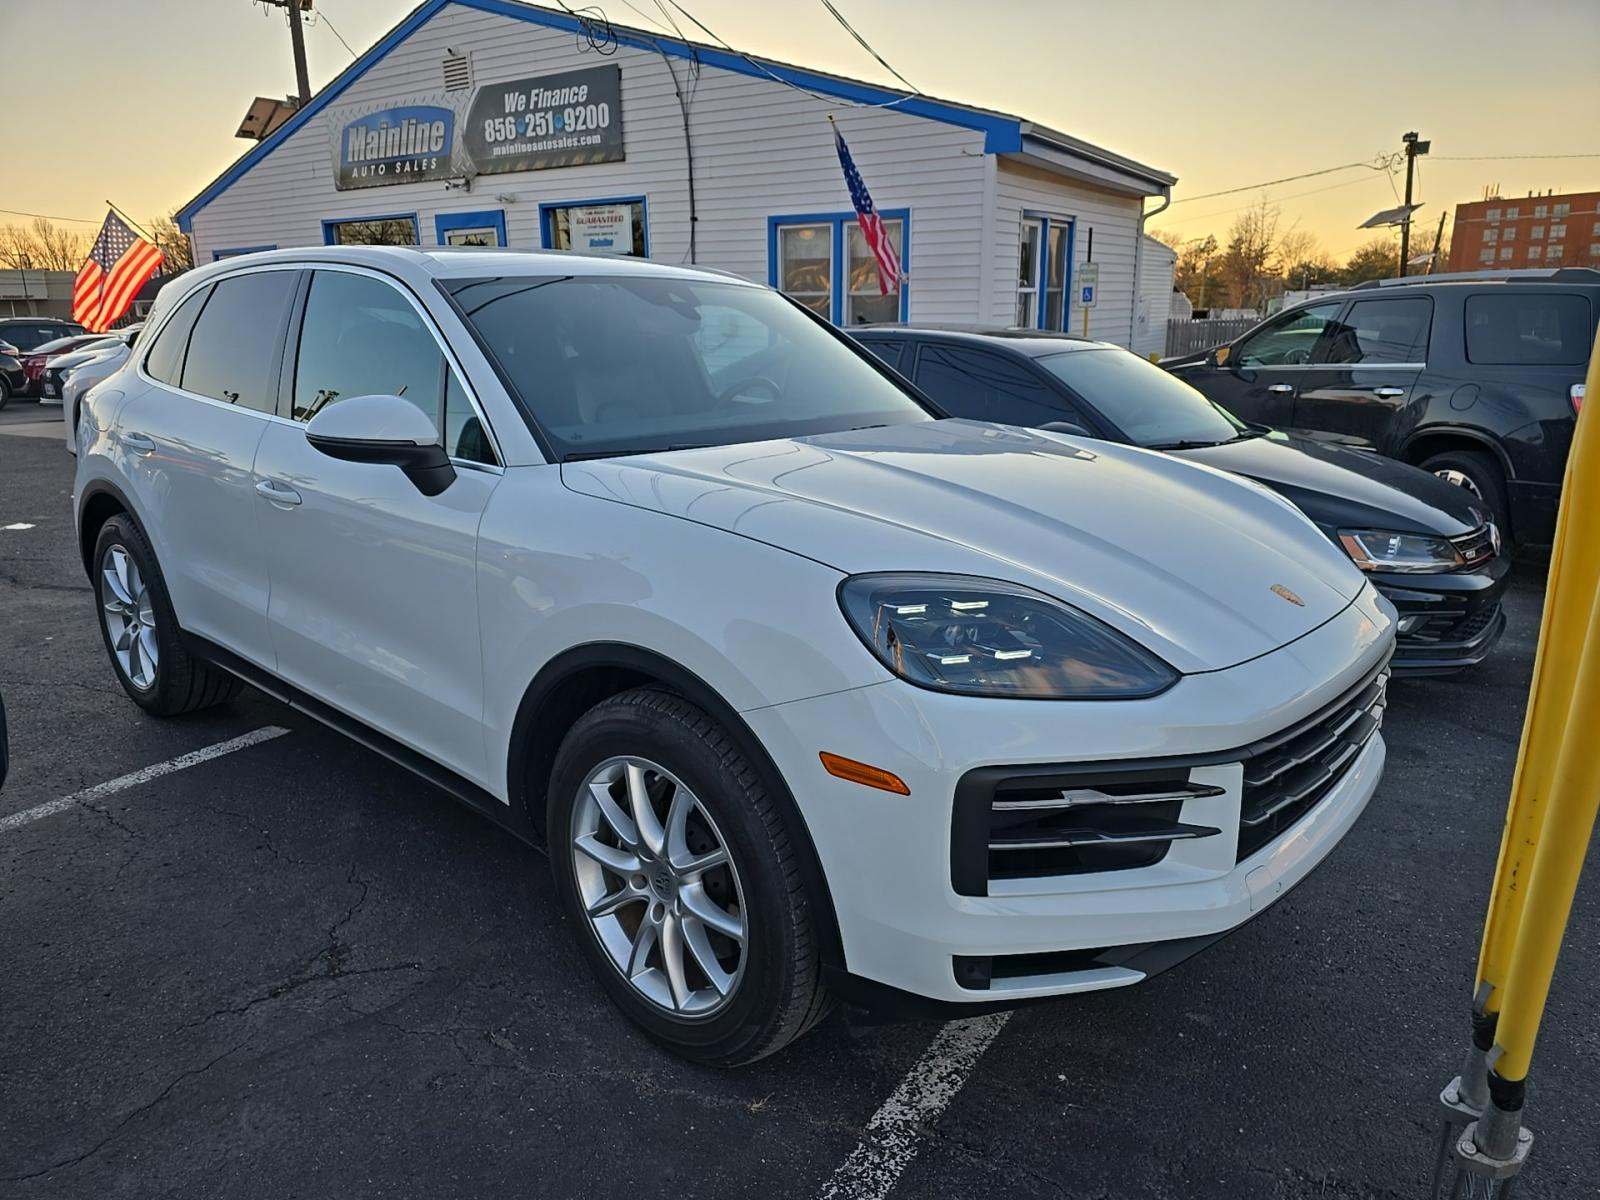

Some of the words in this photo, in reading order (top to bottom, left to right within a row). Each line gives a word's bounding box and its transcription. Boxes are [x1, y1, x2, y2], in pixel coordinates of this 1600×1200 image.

[504, 92, 526, 113] We
[529, 84, 589, 110] Finance
[347, 118, 445, 162] Mainline
[493, 134, 602, 156] mainlineautosales.com
[352, 163, 386, 178] AUTO
[395, 157, 437, 174] SALES
